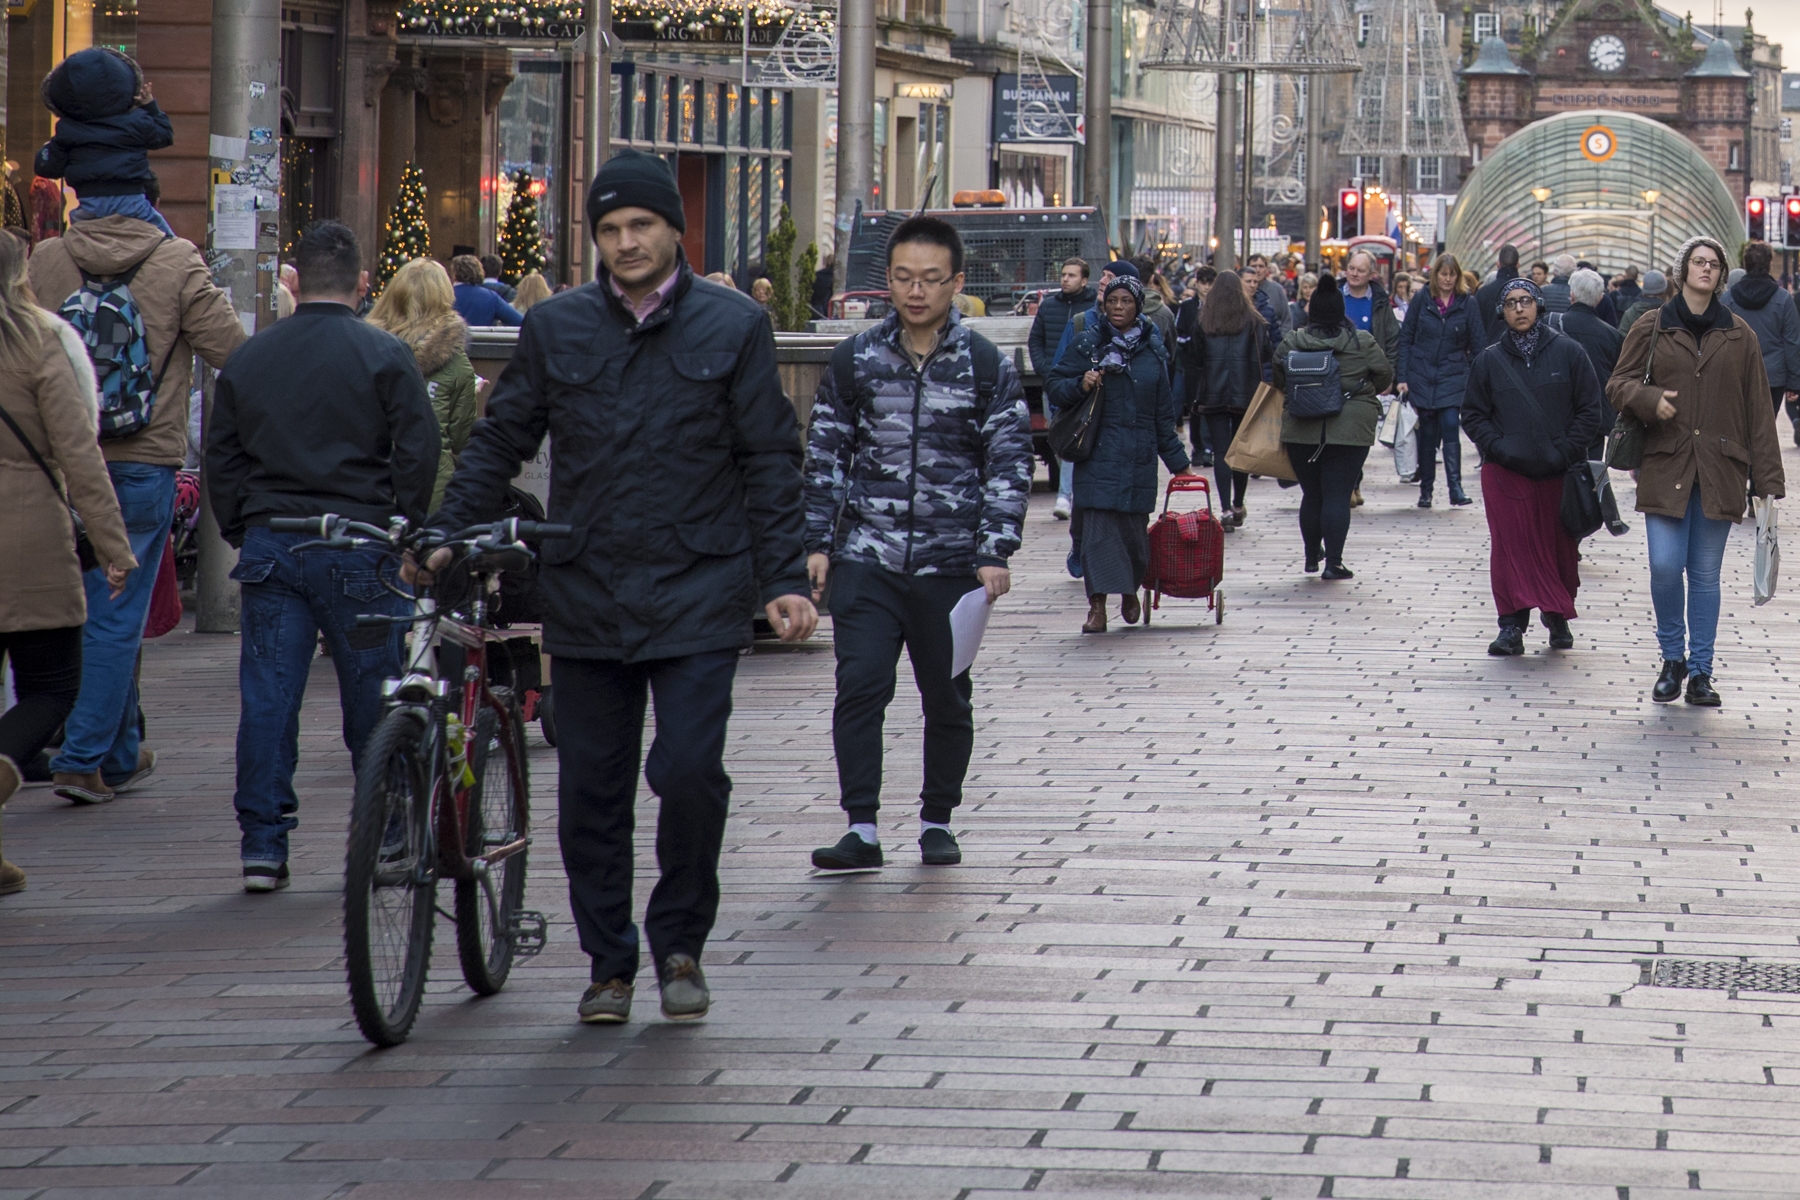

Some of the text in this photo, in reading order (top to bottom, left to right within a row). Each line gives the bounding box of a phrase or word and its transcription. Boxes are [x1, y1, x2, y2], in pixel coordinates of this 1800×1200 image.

[724, 29, 773, 43] ARADE
[906, 85, 950, 99] ZARA
[1002, 89, 1070, 102] BUCHANAN
[1611, 95, 1660, 106] NERO
[1594, 138, 1603, 150] S
